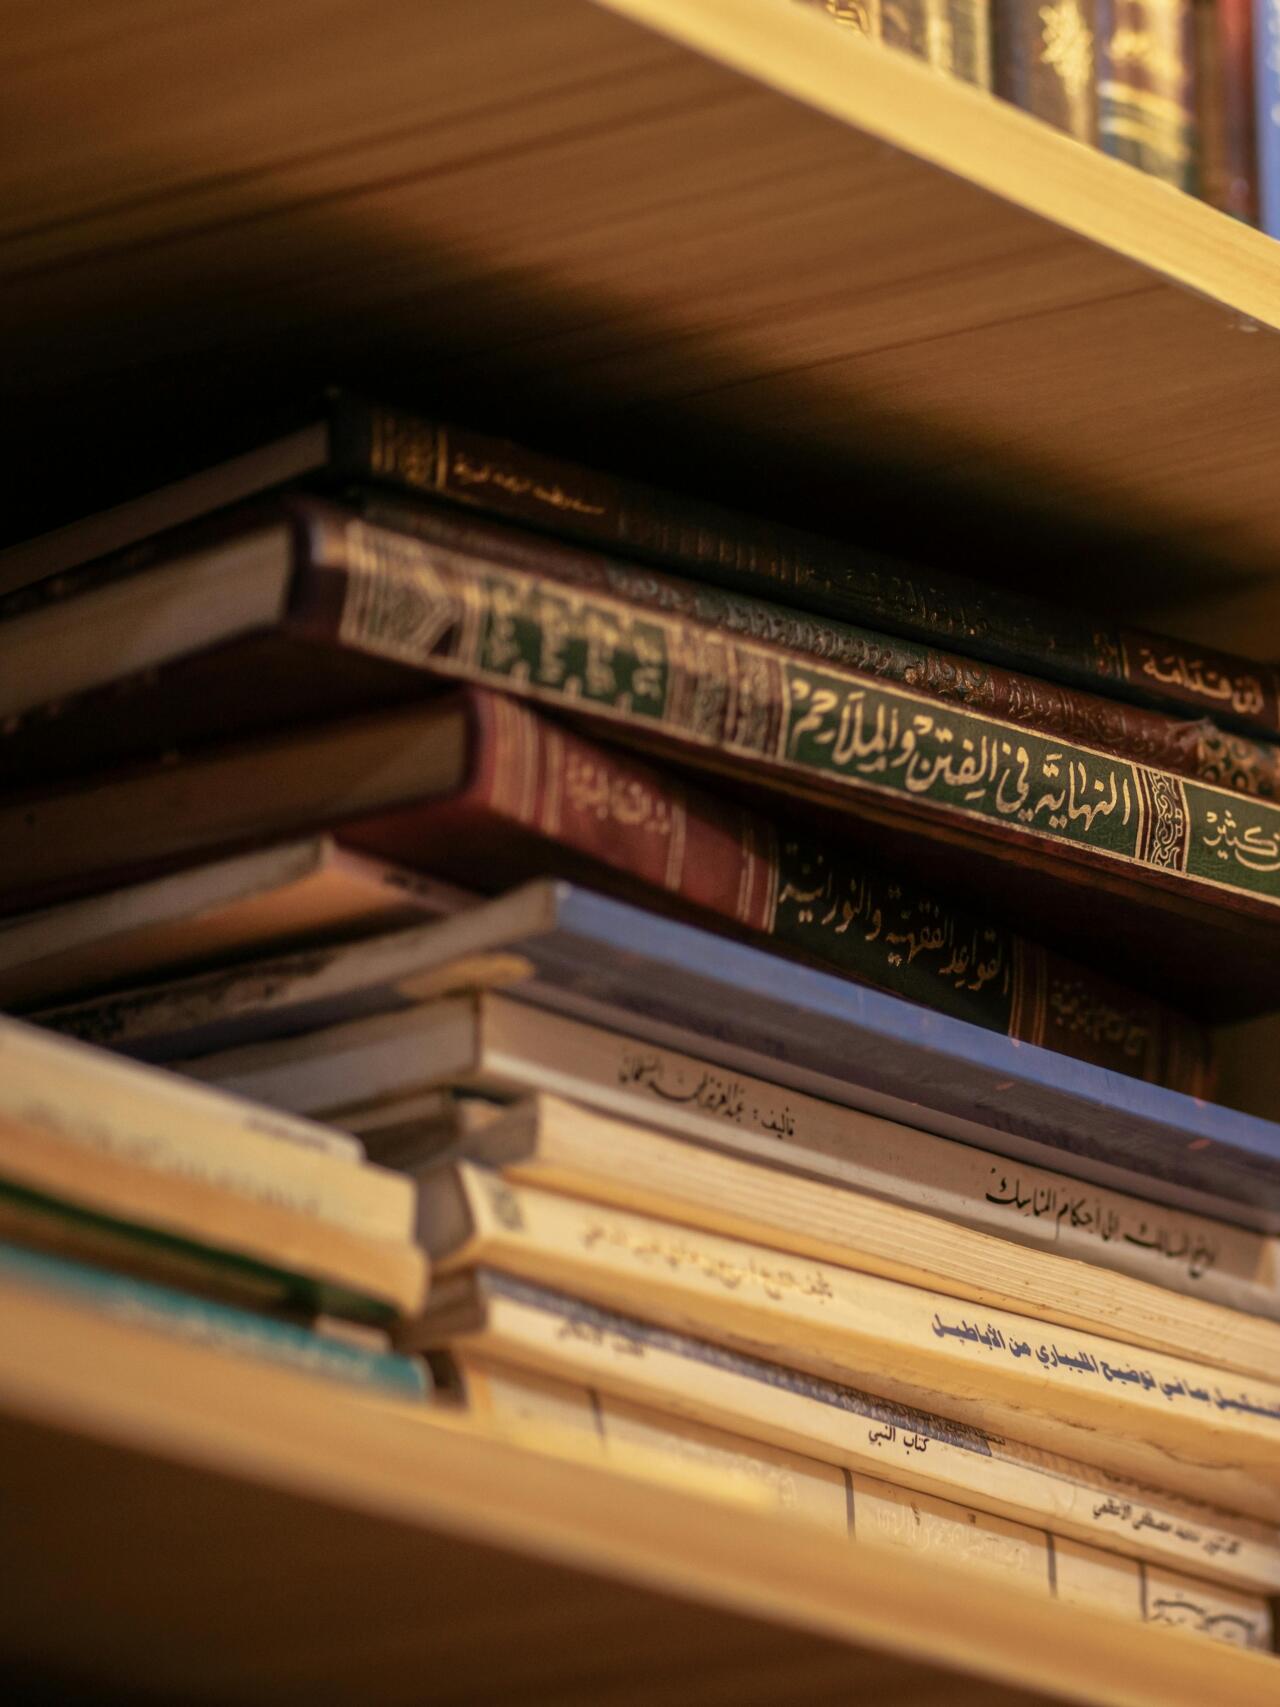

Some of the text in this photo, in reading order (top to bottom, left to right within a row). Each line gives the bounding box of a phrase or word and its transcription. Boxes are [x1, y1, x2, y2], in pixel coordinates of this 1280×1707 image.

[790, 678, 915, 773] والملاحم
[905, 715, 998, 801] الفتن
[995, 741, 1035, 823] في
[1035, 753, 1131, 832] النهاية
[1202, 809, 1278, 860] كثير
[868, 1425, 930, 1455] كتاب النبي
